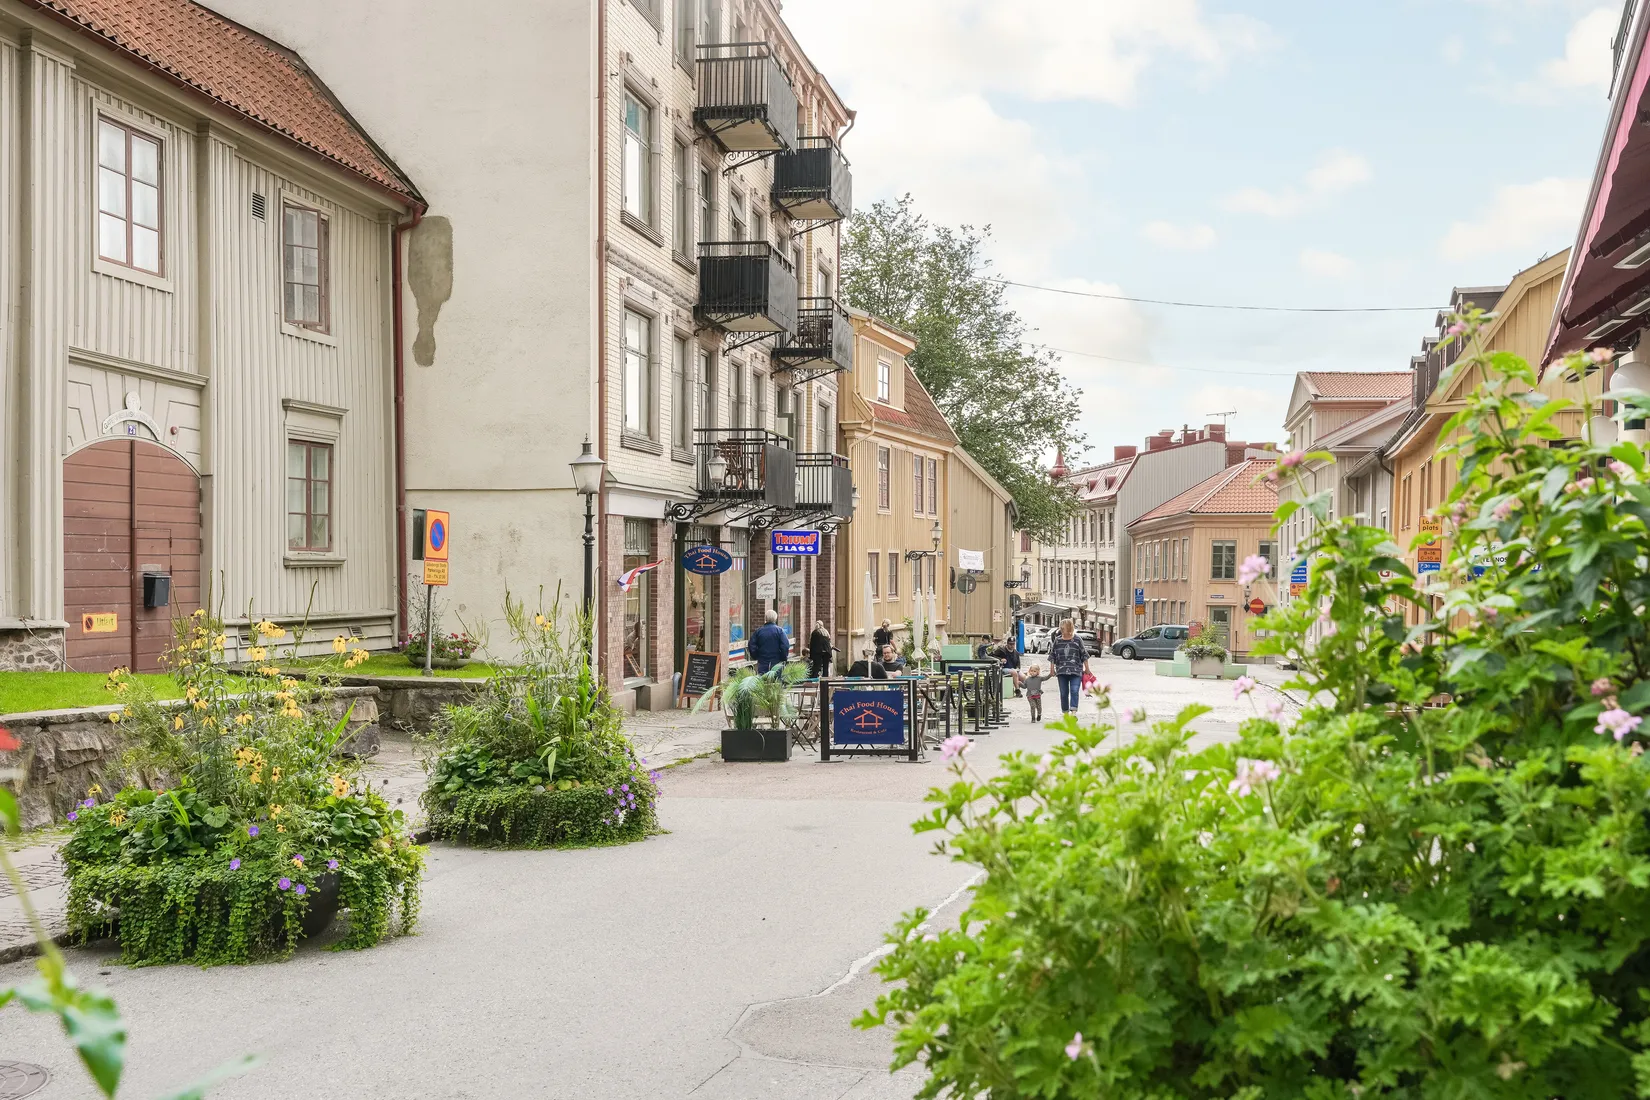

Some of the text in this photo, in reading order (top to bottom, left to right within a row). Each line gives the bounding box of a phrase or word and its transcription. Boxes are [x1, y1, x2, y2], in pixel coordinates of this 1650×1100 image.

[774, 533, 817, 545] TRIUMF
[684, 550, 697, 559] Thai
[713, 548, 729, 560] House
[839, 704, 856, 716] Thai
[877, 701, 899, 716] House
